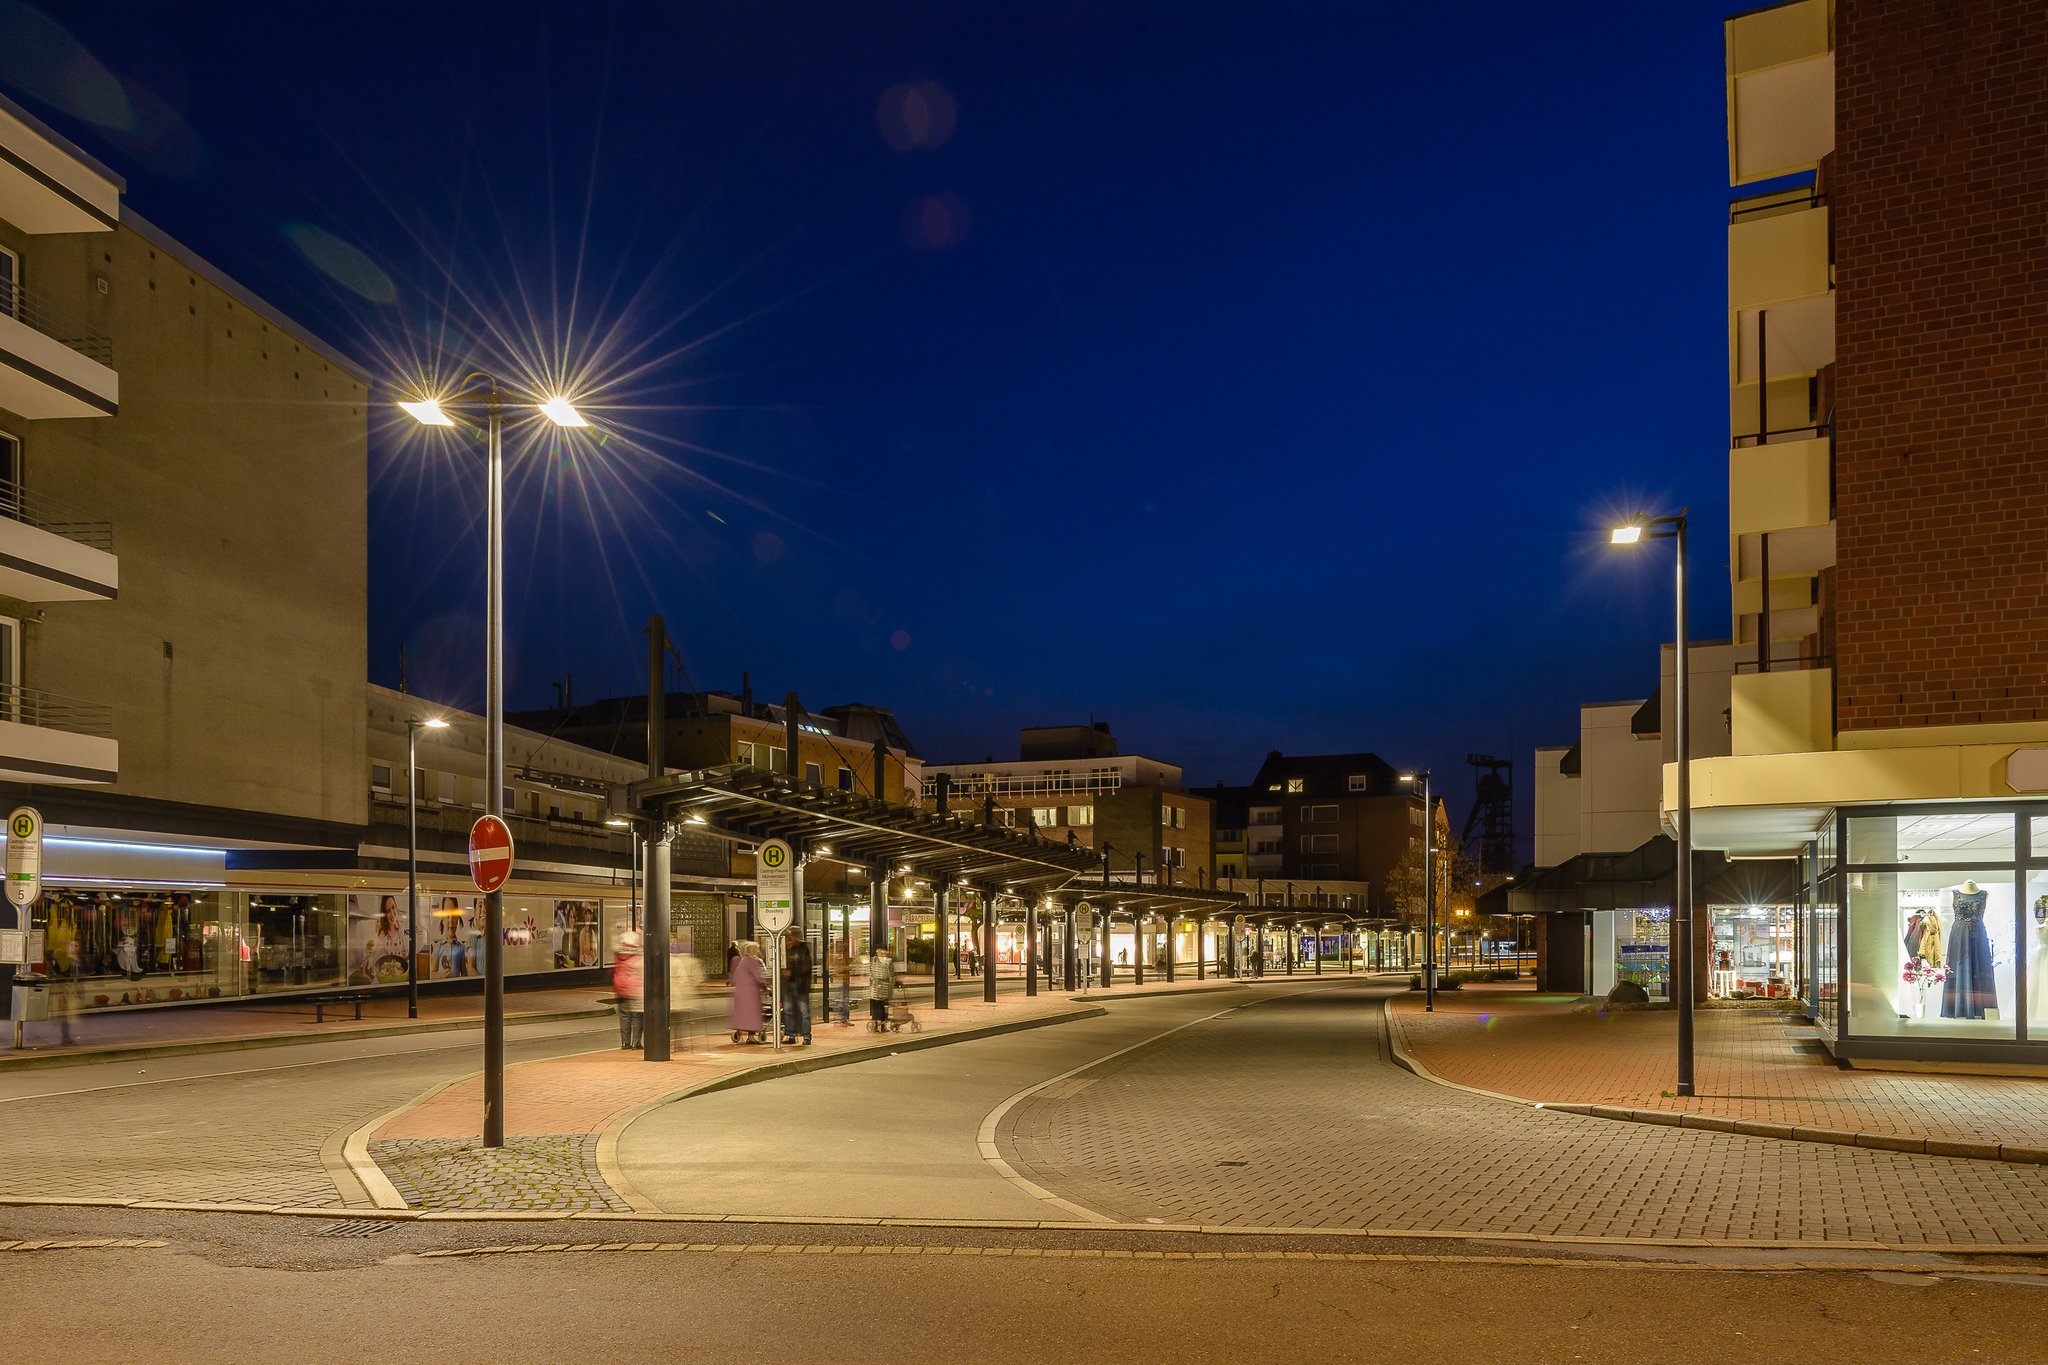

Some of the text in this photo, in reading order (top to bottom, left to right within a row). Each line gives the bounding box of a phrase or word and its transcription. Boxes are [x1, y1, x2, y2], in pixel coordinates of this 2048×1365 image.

[18, 820, 28, 832] H
[769, 850, 779, 862] H
[18, 890, 24, 899] 5
[772, 917, 777, 926] 1
